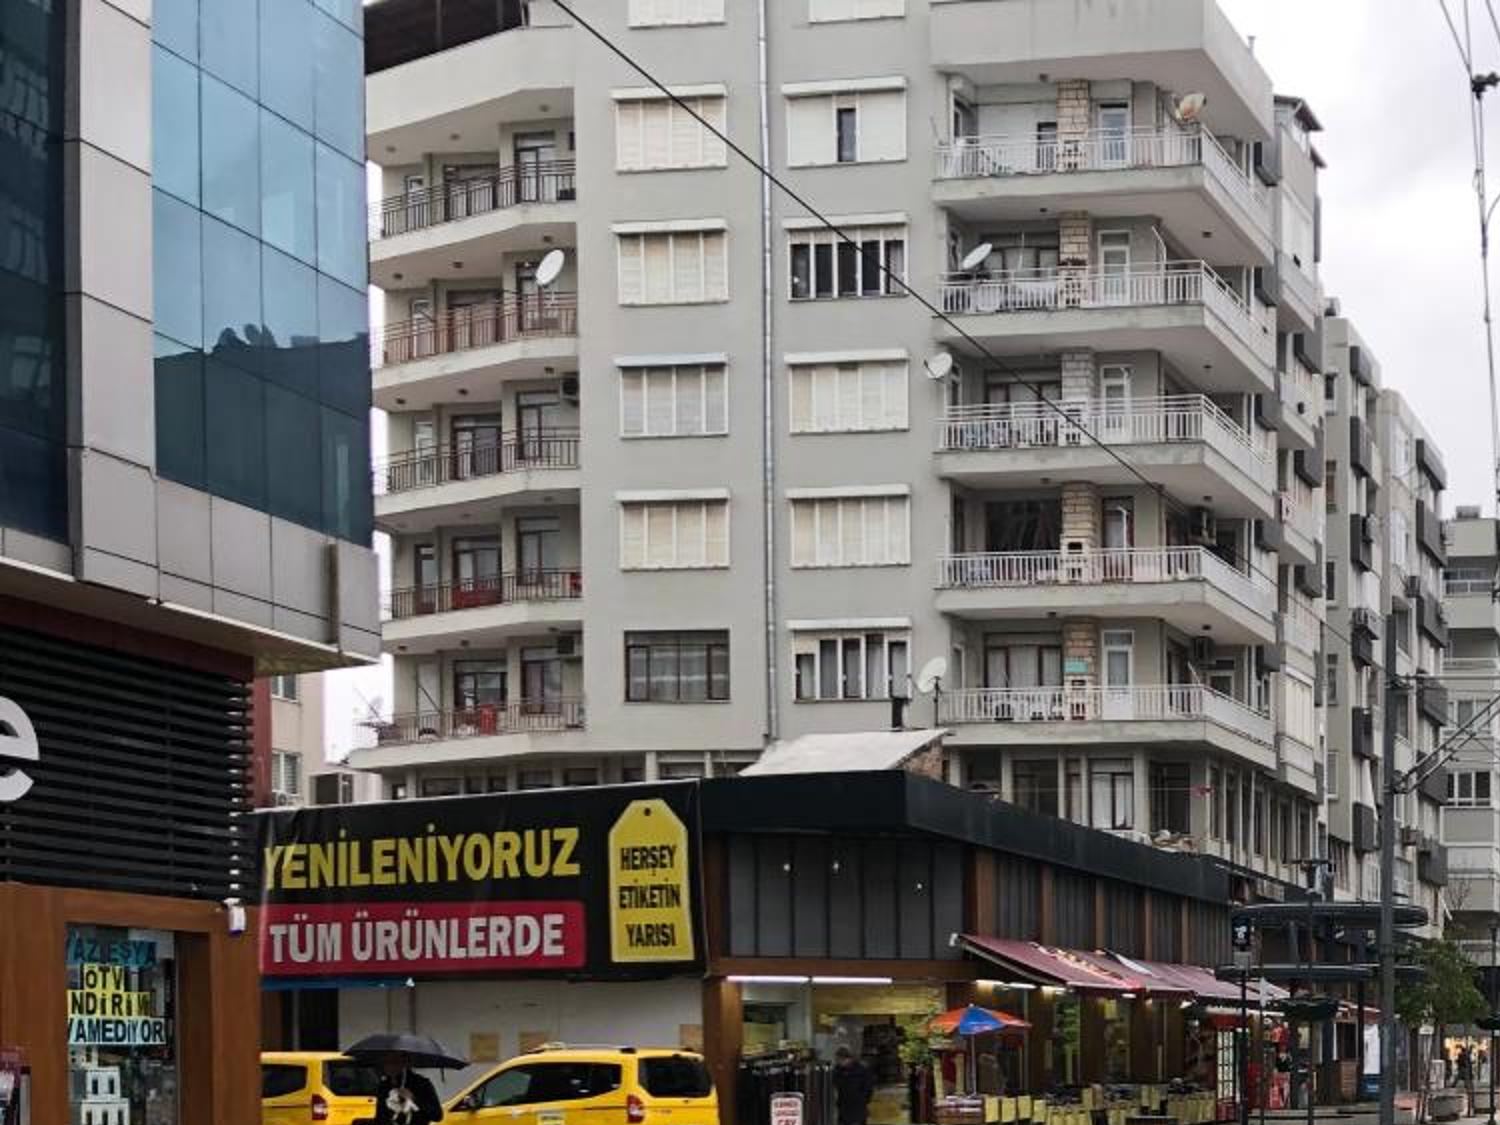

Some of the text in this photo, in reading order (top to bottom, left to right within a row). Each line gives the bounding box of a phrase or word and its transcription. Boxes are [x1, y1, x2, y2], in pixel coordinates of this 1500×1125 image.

[264, 823, 580, 890] YENİLENİYORUZ
[619, 877, 681, 909] ETİKETİN
[269, 908, 564, 963] TÜM ÜRÜNLERDE
[625, 923, 677, 947] YARISI
